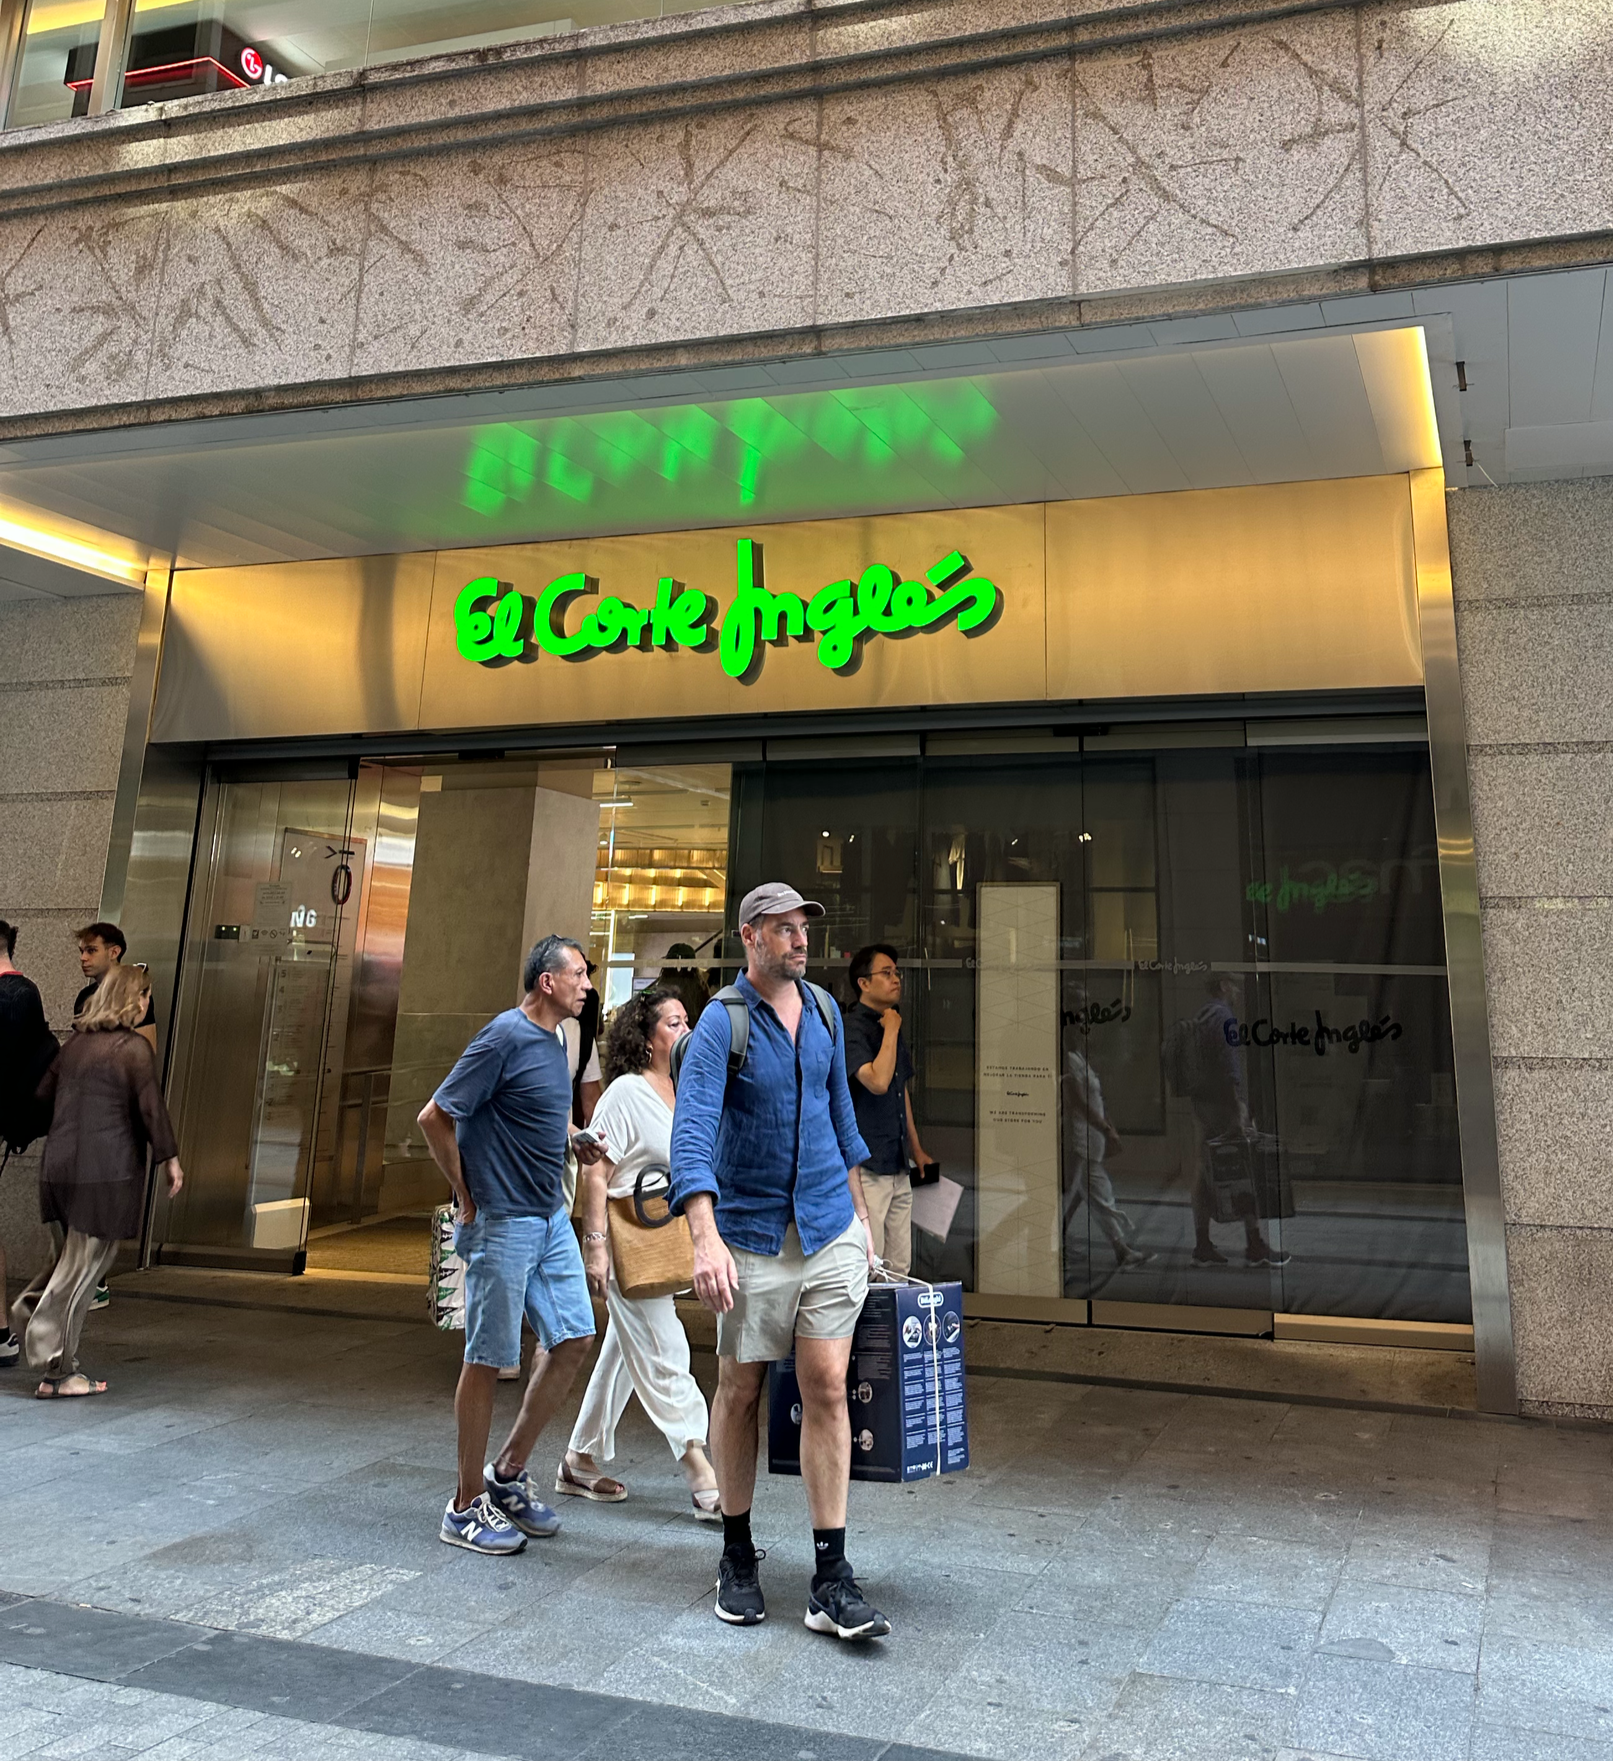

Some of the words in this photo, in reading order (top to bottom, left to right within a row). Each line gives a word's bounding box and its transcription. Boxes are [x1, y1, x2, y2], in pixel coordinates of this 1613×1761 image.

[455, 578, 523, 662] El
[534, 573, 706, 662] Corte
[720, 539, 996, 677] Inglés
[1149, 960, 1173, 971] Corte
[1061, 998, 1132, 1036] nglés
[1224, 1017, 1251, 1047] El
[1251, 1019, 1311, 1047] Corte
[1315, 1010, 1403, 1056] Inglés
[460, 1521, 482, 1542] N
